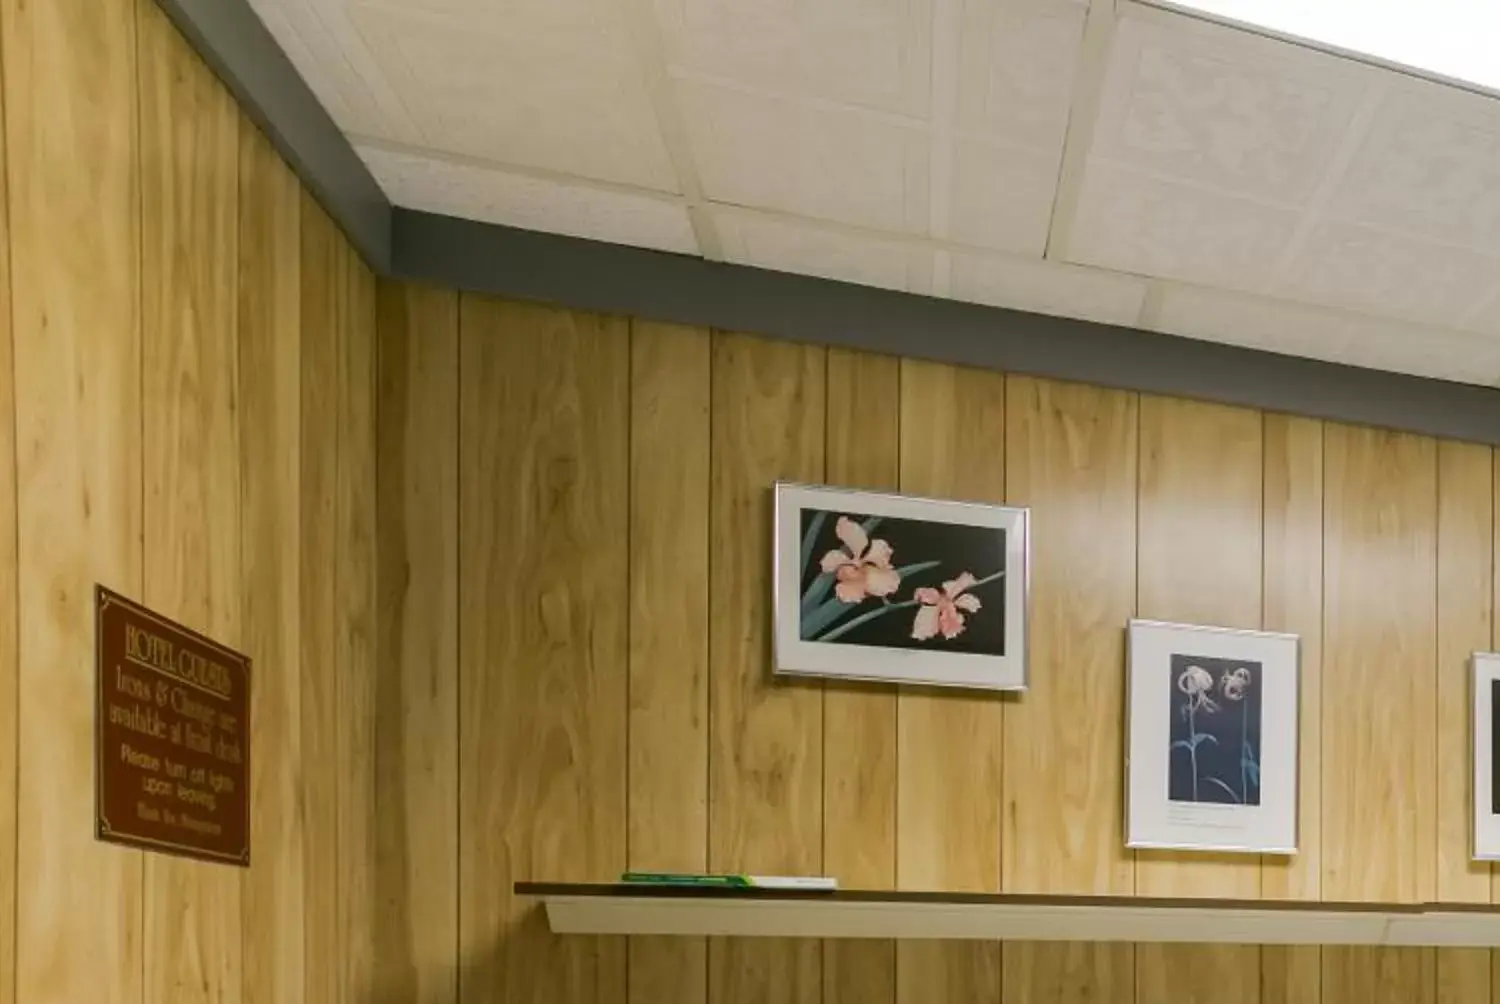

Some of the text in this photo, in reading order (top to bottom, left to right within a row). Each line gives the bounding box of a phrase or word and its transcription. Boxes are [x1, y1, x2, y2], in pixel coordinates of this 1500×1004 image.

[126, 621, 177, 673] HOTEL
[109, 702, 168, 739] available
[121, 742, 160, 772] Please
